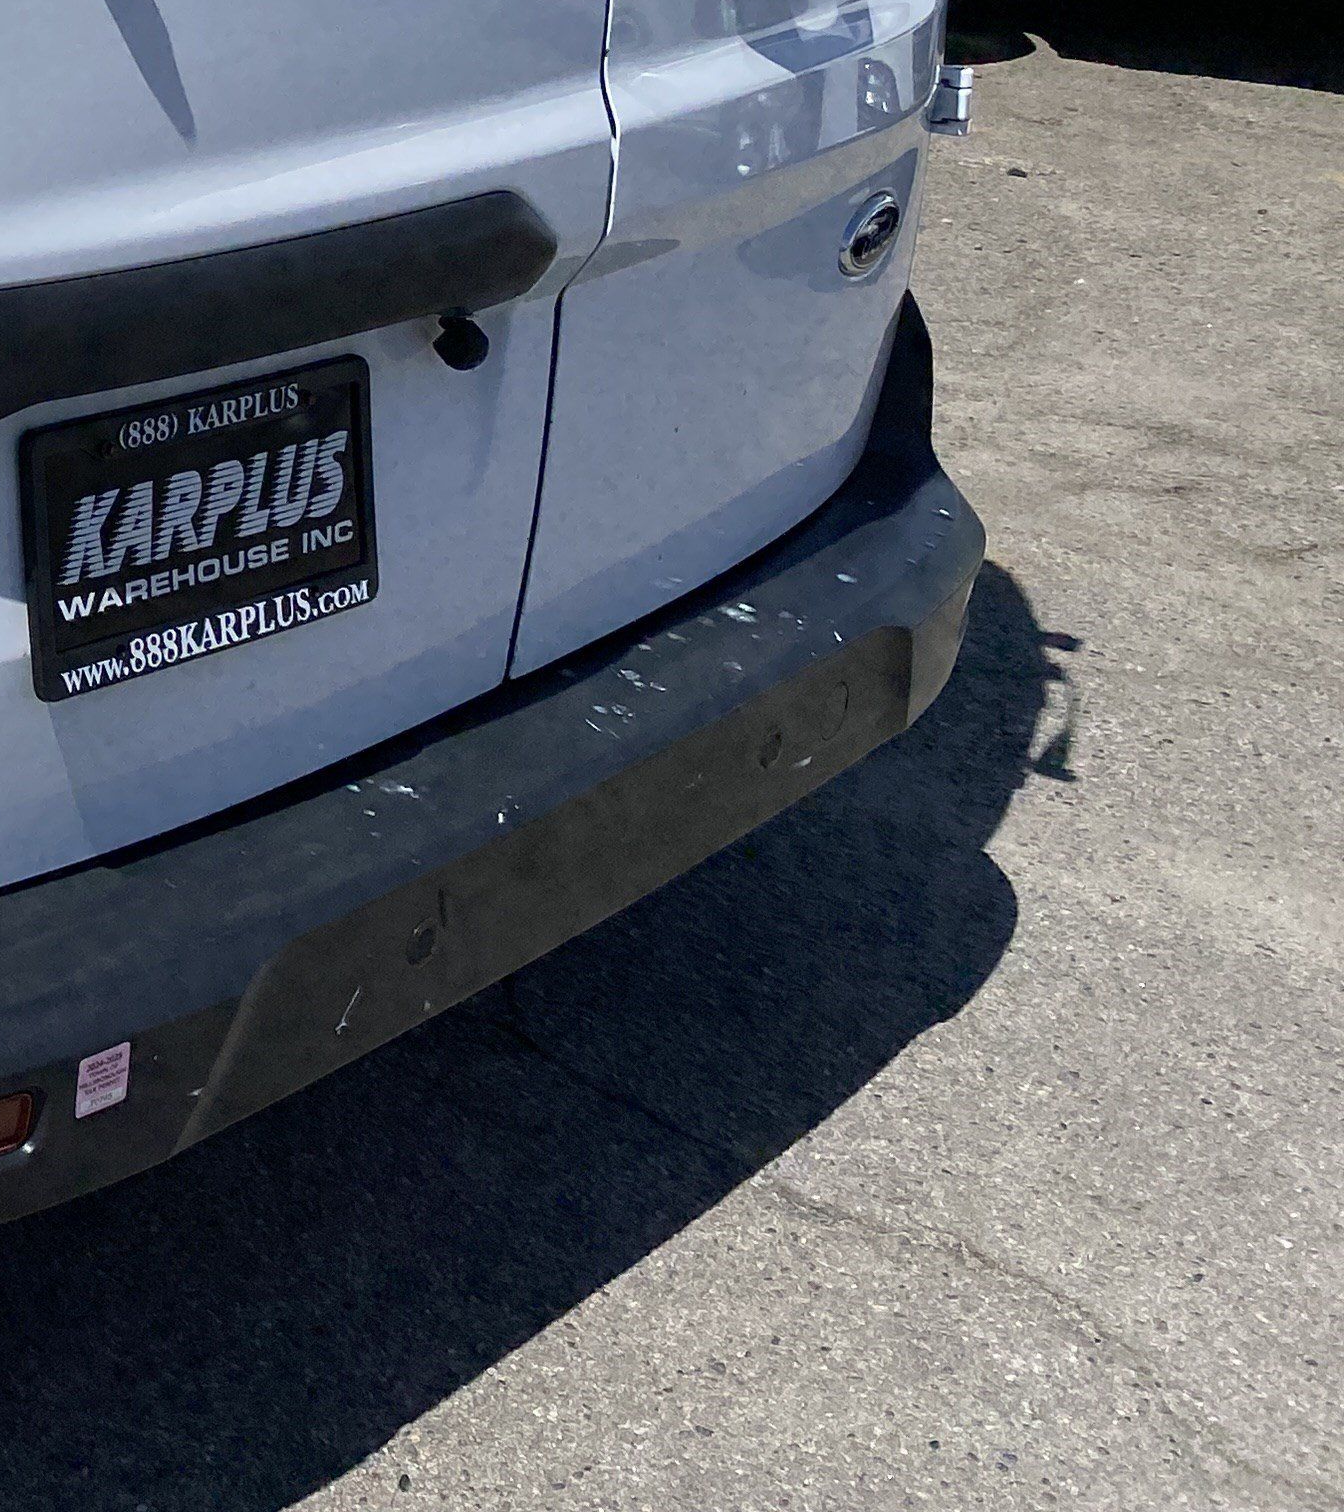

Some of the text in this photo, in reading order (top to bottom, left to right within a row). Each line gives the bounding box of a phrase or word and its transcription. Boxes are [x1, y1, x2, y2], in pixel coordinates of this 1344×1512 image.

[118, 383, 299, 450] (888) KARPLUS
[57, 430, 348, 587] KARPLUS
[58, 519, 354, 622] WAREHOUSE INC
